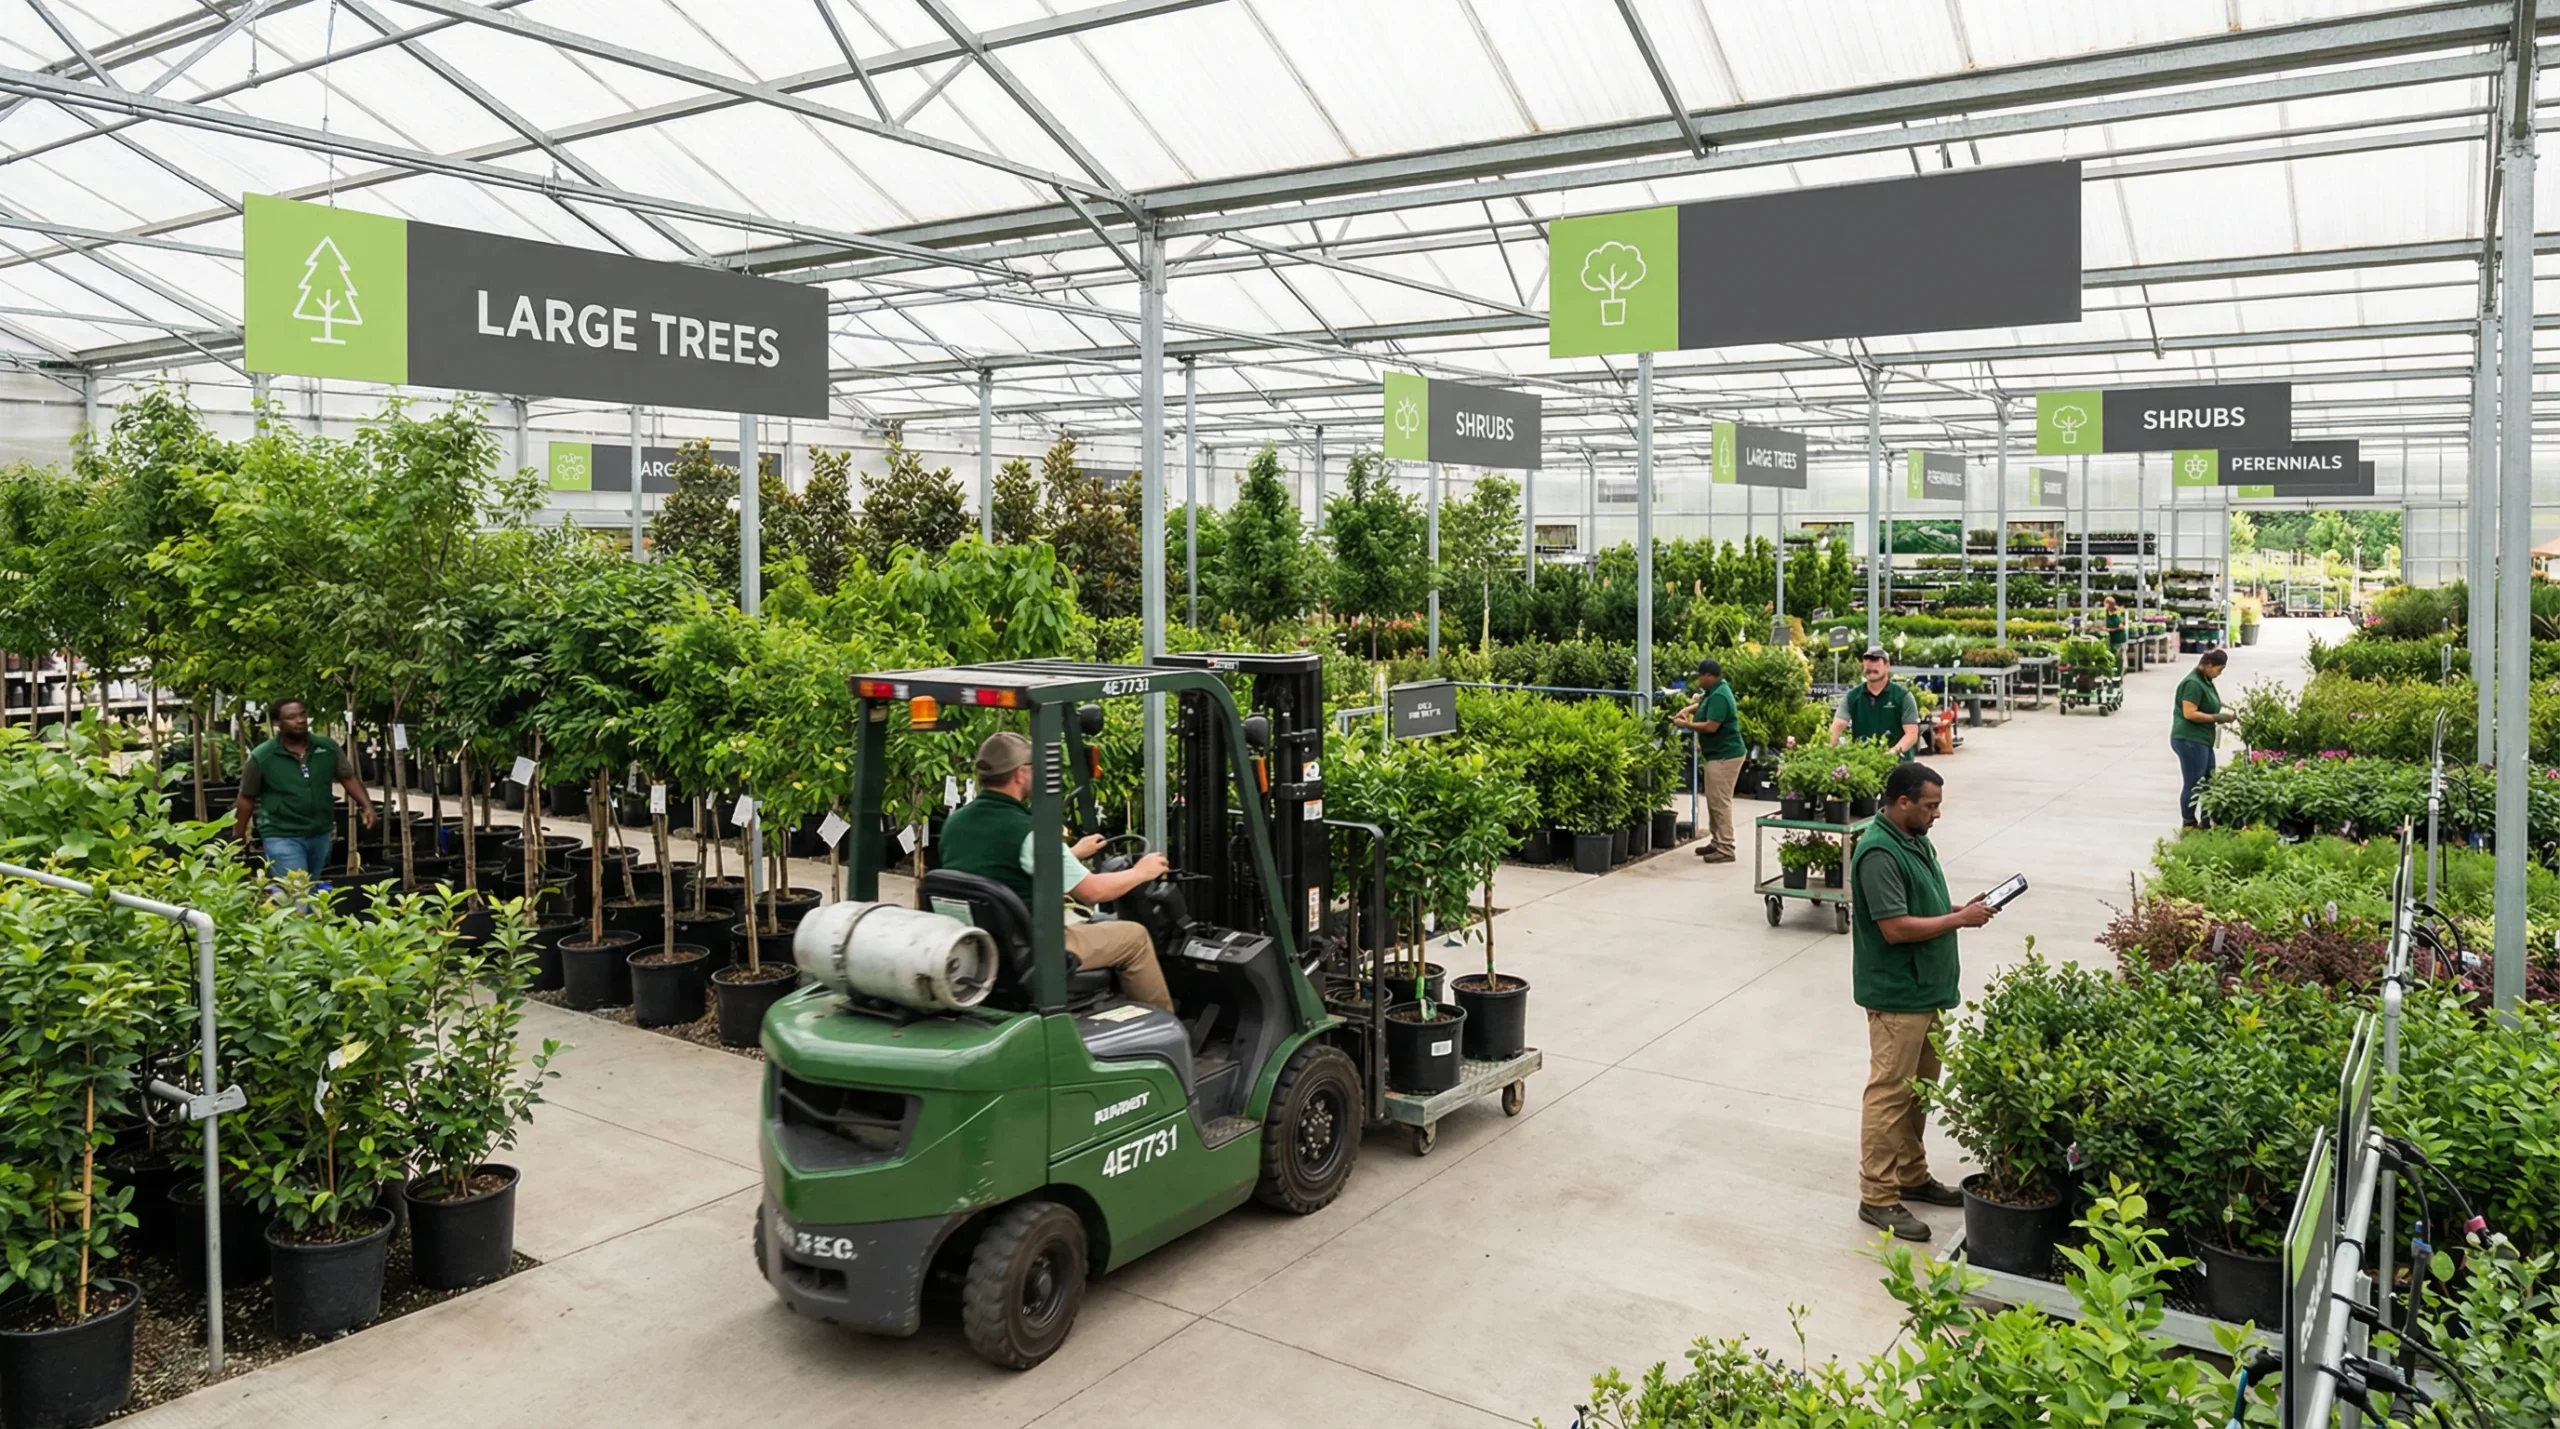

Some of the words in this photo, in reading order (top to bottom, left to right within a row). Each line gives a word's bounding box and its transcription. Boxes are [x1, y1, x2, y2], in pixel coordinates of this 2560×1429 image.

[476, 289, 638, 353] LARGE
[651, 312, 782, 368] TREES
[1455, 410, 1515, 442] SHRUBS
[2143, 406, 2246, 430] SHRUBS
[2231, 455, 2343, 471] PERENNIALS
[1101, 677, 1150, 696] 4E7731
[1101, 1123, 1178, 1178] 4E7731
